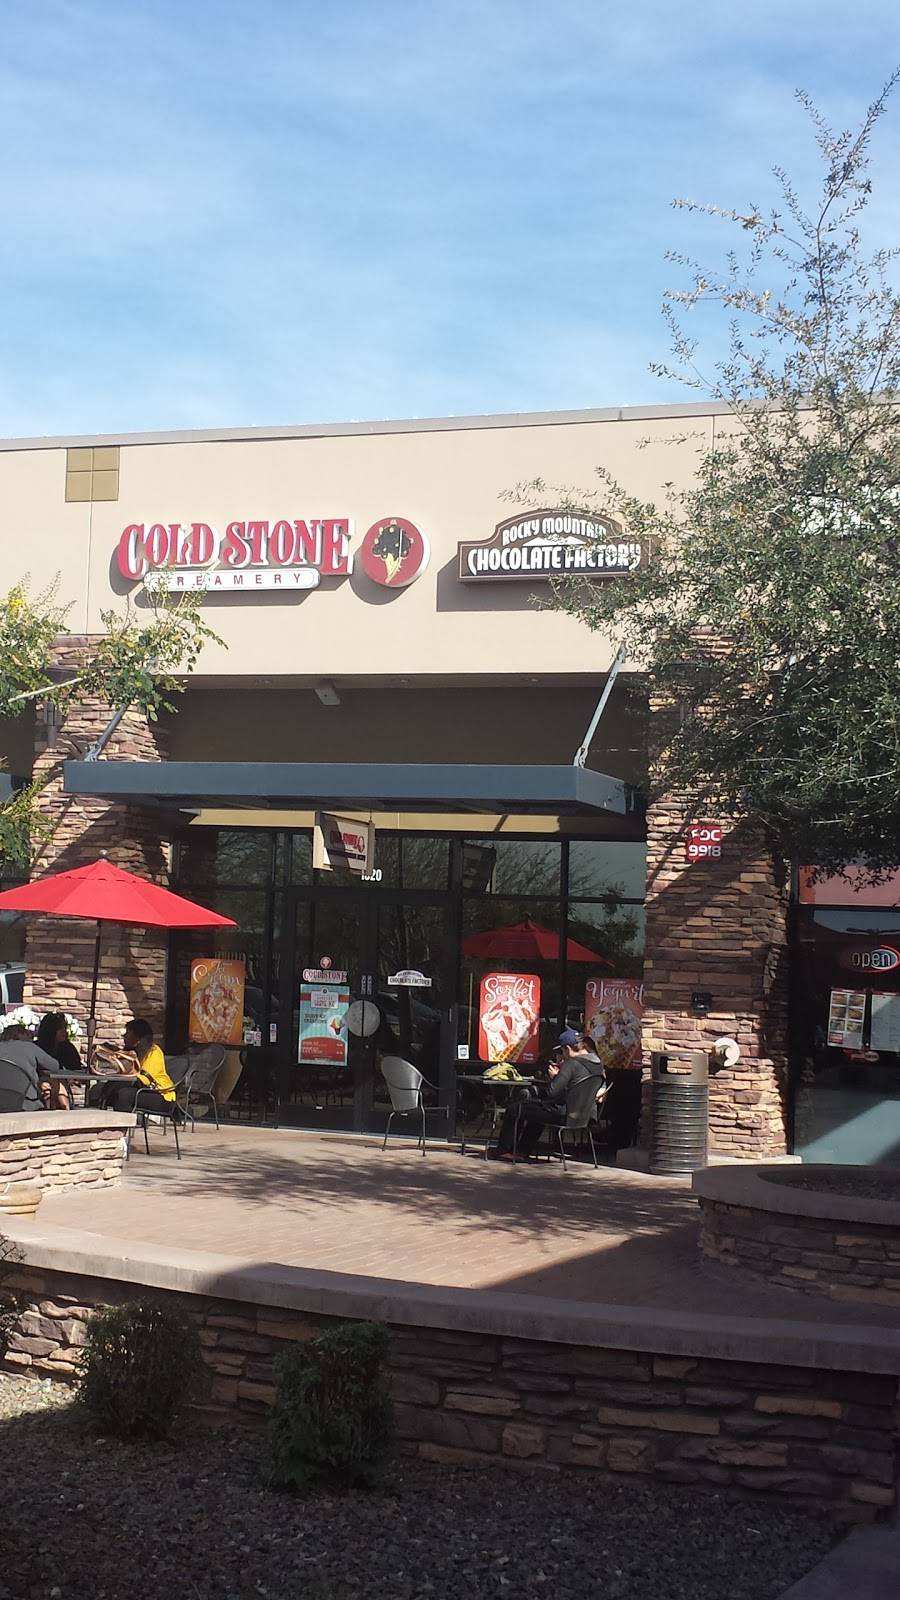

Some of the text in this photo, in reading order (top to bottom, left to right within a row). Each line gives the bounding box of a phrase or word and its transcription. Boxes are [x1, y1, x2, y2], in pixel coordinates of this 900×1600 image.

[502, 517, 540, 546] ROCKY
[118, 518, 352, 581] COLD STONE
[467, 545, 562, 576] CHOCOLATE
[157, 572, 302, 587] REAMERY
[688, 845, 721, 857] 9918
[851, 952, 891, 968] open
[485, 975, 535, 1003] Sorbet
[586, 980, 645, 1008] Yogurt
